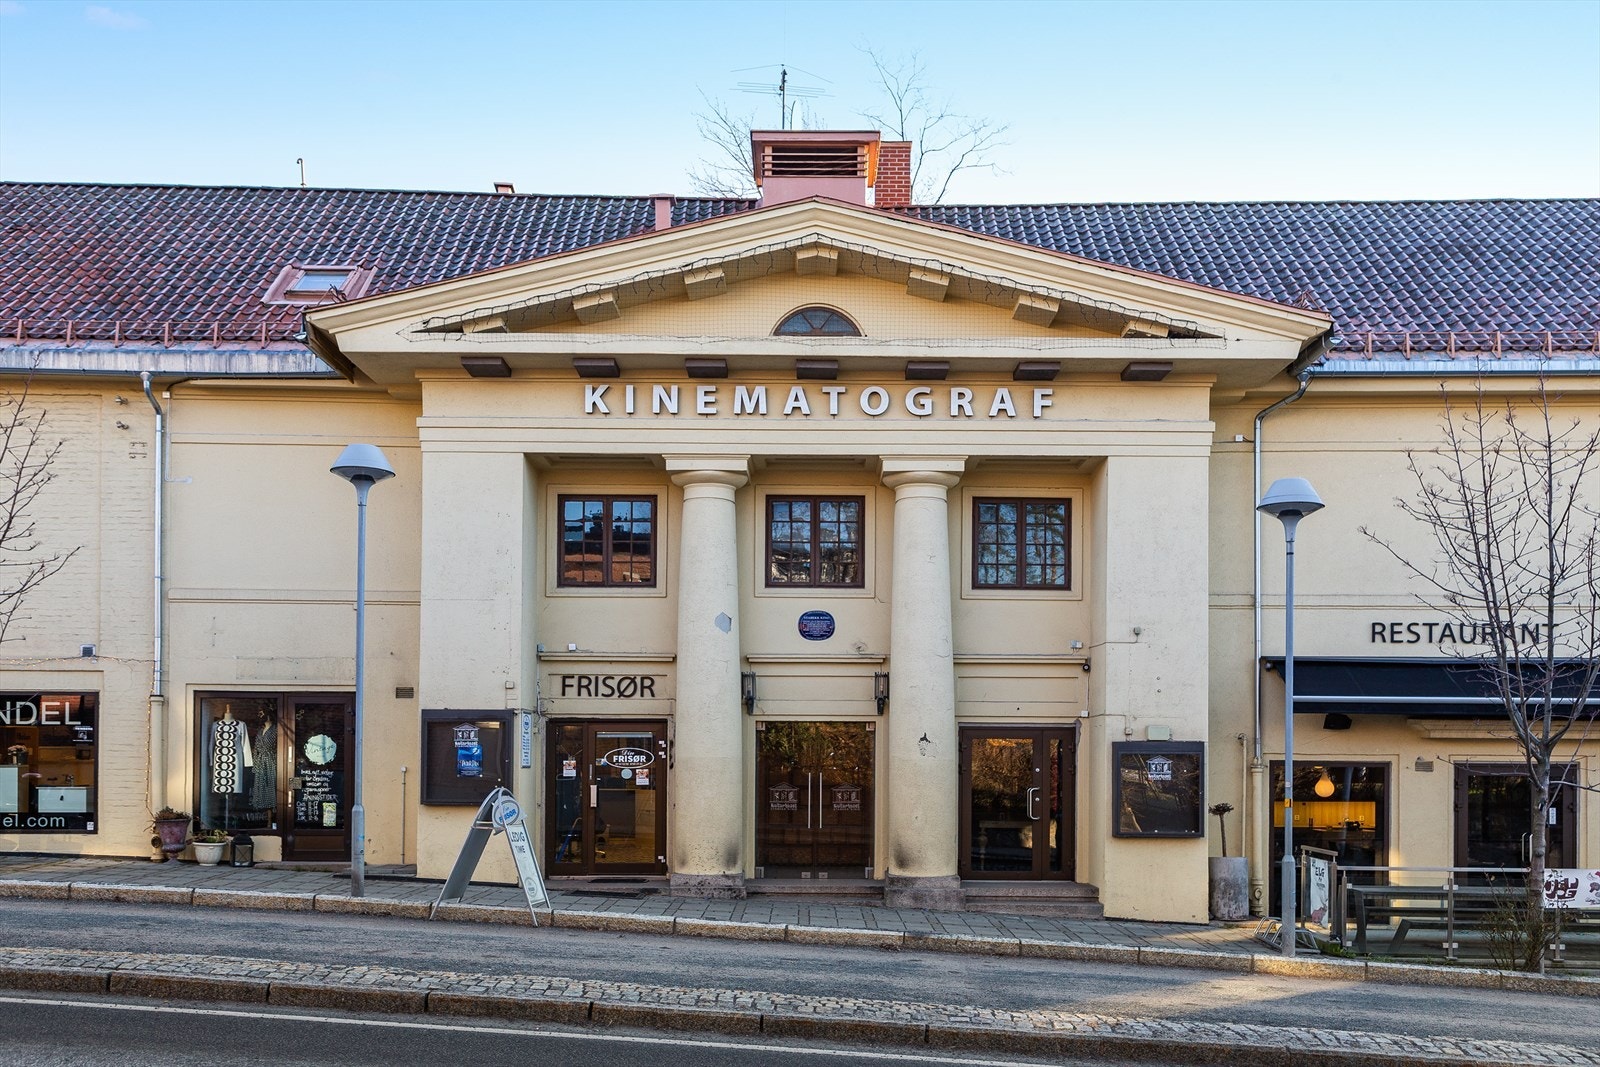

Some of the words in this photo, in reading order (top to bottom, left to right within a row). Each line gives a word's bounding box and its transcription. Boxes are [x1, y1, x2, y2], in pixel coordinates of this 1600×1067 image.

[584, 384, 1054, 418] KINEMATOGRAF
[561, 675, 655, 698] FRISØR
[2, 814, 65, 827] el.com
[510, 831, 526, 842] LEDIG
